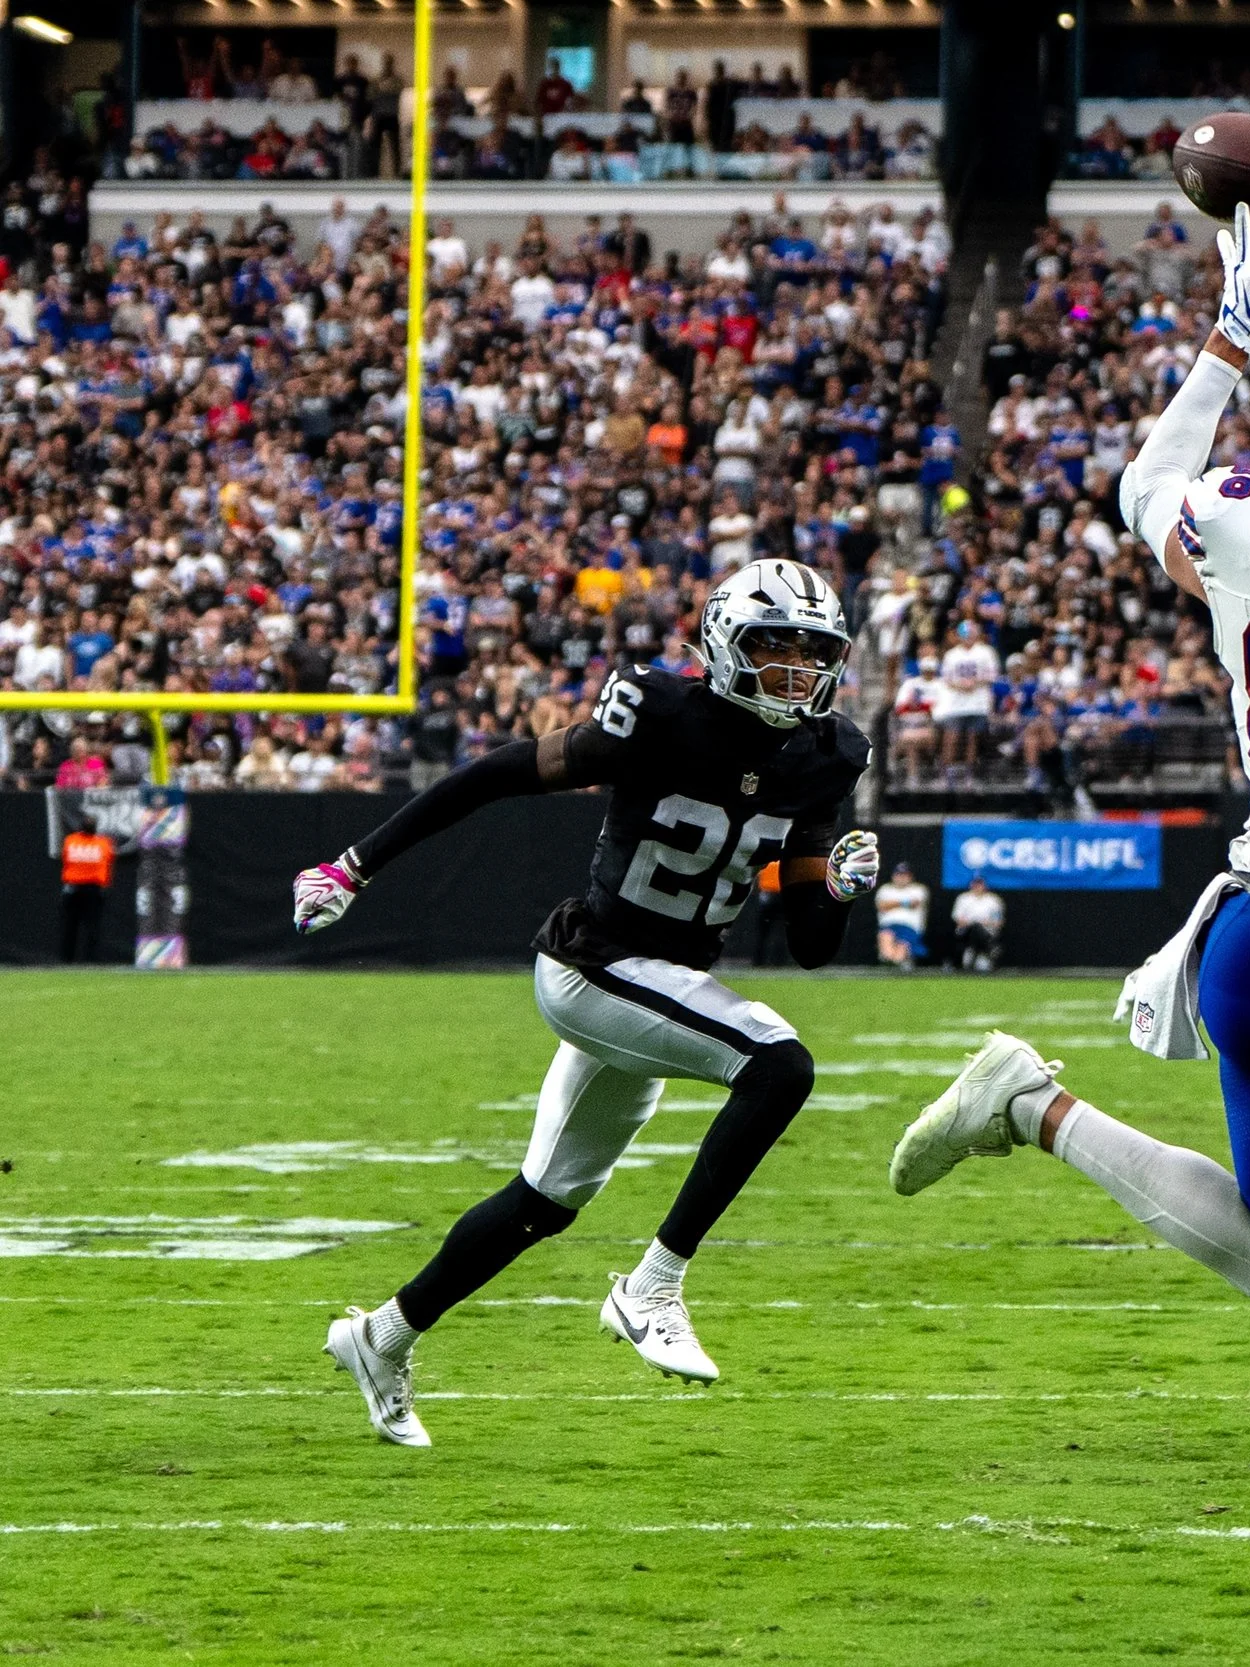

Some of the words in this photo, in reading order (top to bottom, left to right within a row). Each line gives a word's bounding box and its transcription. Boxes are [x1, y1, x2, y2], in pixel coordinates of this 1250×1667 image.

[618, 794, 794, 926] 26
[988, 838, 1057, 869] CBS
[1074, 838, 1143, 869] NFL
